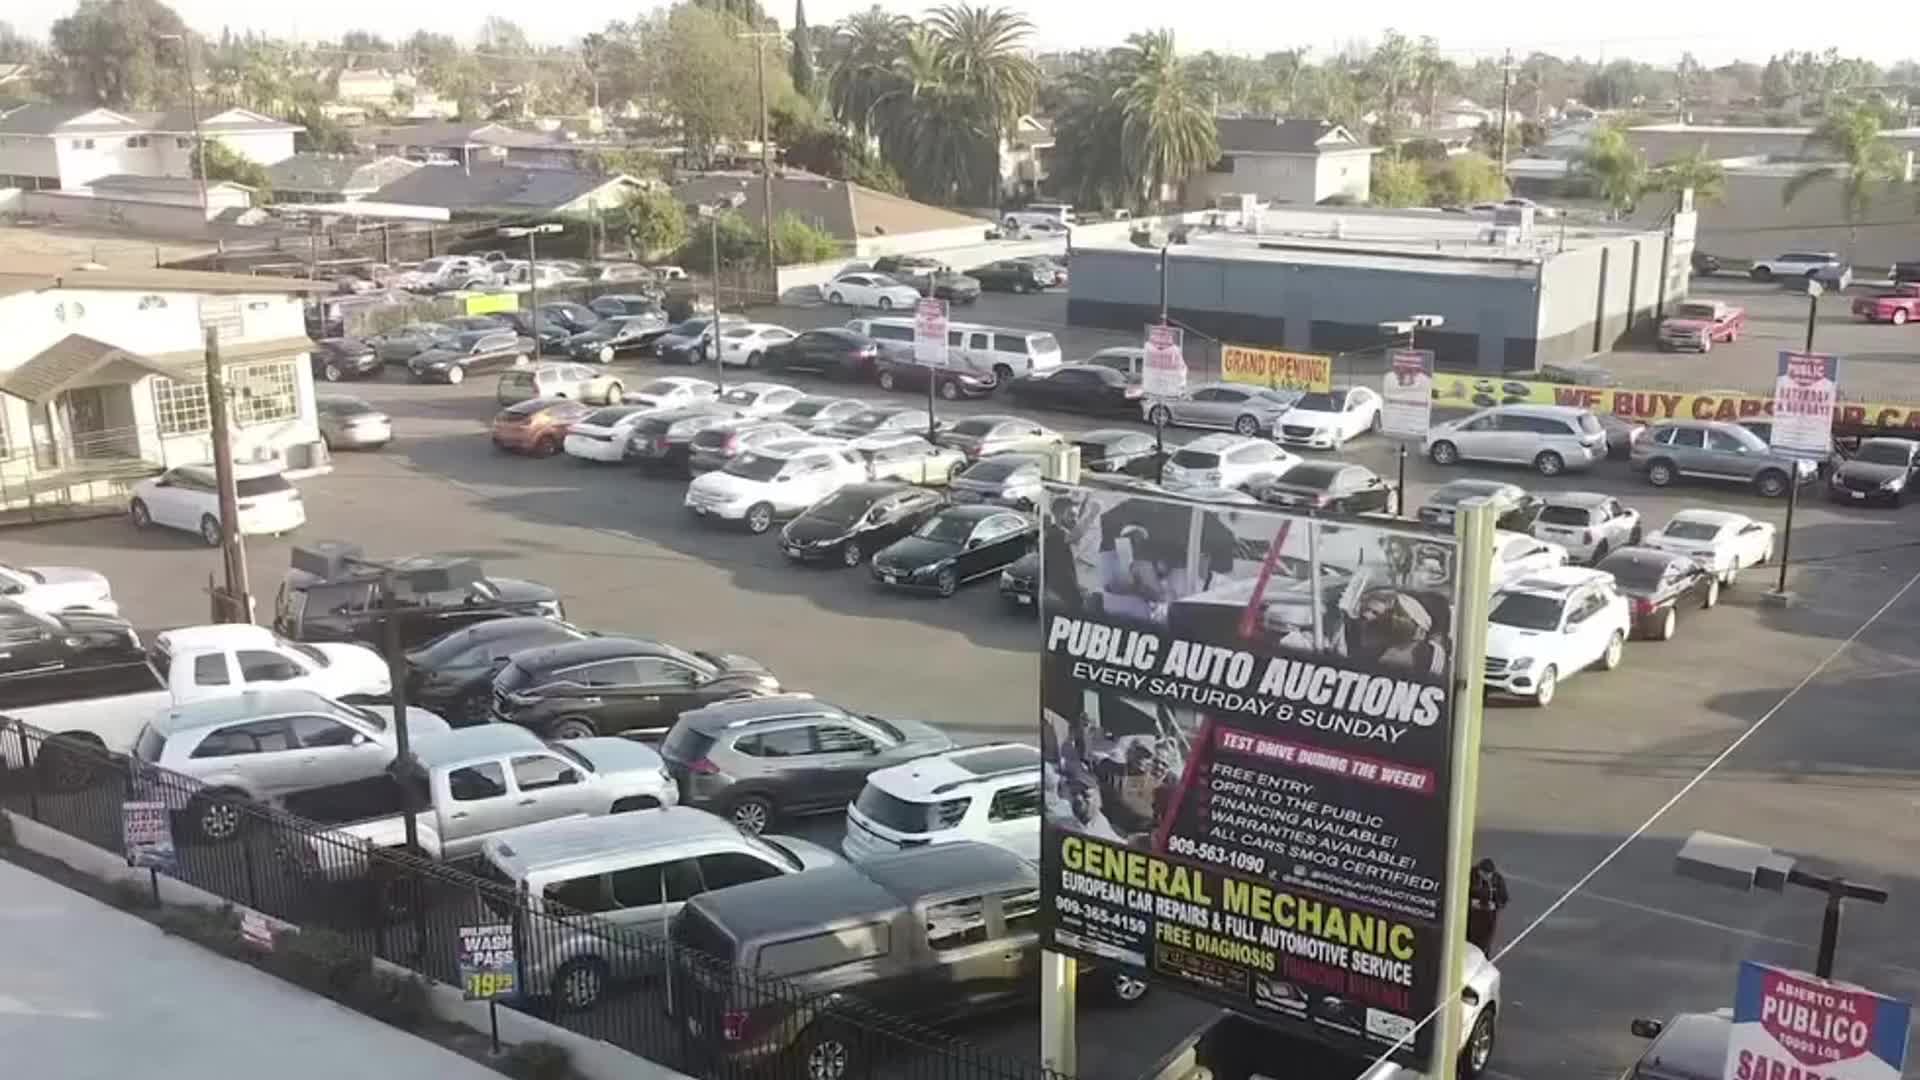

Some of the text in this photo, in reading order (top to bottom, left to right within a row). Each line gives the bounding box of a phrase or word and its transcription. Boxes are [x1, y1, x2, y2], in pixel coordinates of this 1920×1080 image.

[1224, 350, 1328, 384] GRAND OPENING!
[1787, 362, 1825, 378] PUBLIC
[1613, 391, 1684, 420] BUY
[1779, 387, 1829, 402] SATURDAY
[1048, 616, 1445, 726] PUBLIC AUTO AUCTIONS
[1072, 662, 1147, 690] EVERY
[1148, 678, 1275, 717] SATURDAY
[1299, 708, 1408, 744] SUNDAY
[1210, 762, 1315, 795] FREE ENTRY
[1223, 732, 1428, 790] TEST DRIVE DURING THE WEEK!
[1210, 780, 1384, 829] OPEN TO THE PUBLIC
[1210, 794, 1400, 849] FINANCING AVAILABLE!
[1168, 835, 1266, 874] 909-563-1090
[1209, 826, 1440, 891] ALL CARS SMOG CERTIFIED!
[1210, 810, 1417, 870] WARRANTIES AVAILABLE!
[1062, 836, 1211, 905] GENERAL
[1222, 877, 1415, 960] MECHANIC
[463, 936, 513, 952] WASH
[1062, 869, 1125, 907] EUROPEAN
[1126, 889, 1153, 913] CAR
[1155, 895, 1209, 929] REPAIRS
[1211, 911, 1222, 932] &
[1224, 914, 1258, 942] FULL
[1260, 925, 1349, 969] AUTOMOTIVE
[1351, 950, 1413, 987] SERVICE
[1155, 921, 1192, 949] FREE
[1194, 931, 1276, 972] DIAGNOSIS
[473, 950, 515, 969] PASS
[1761, 995, 1868, 1049] PUBLICO
[1776, 981, 1857, 1014] ABIERTO AL
[1778, 1032, 1841, 1061] TODOS LOS
